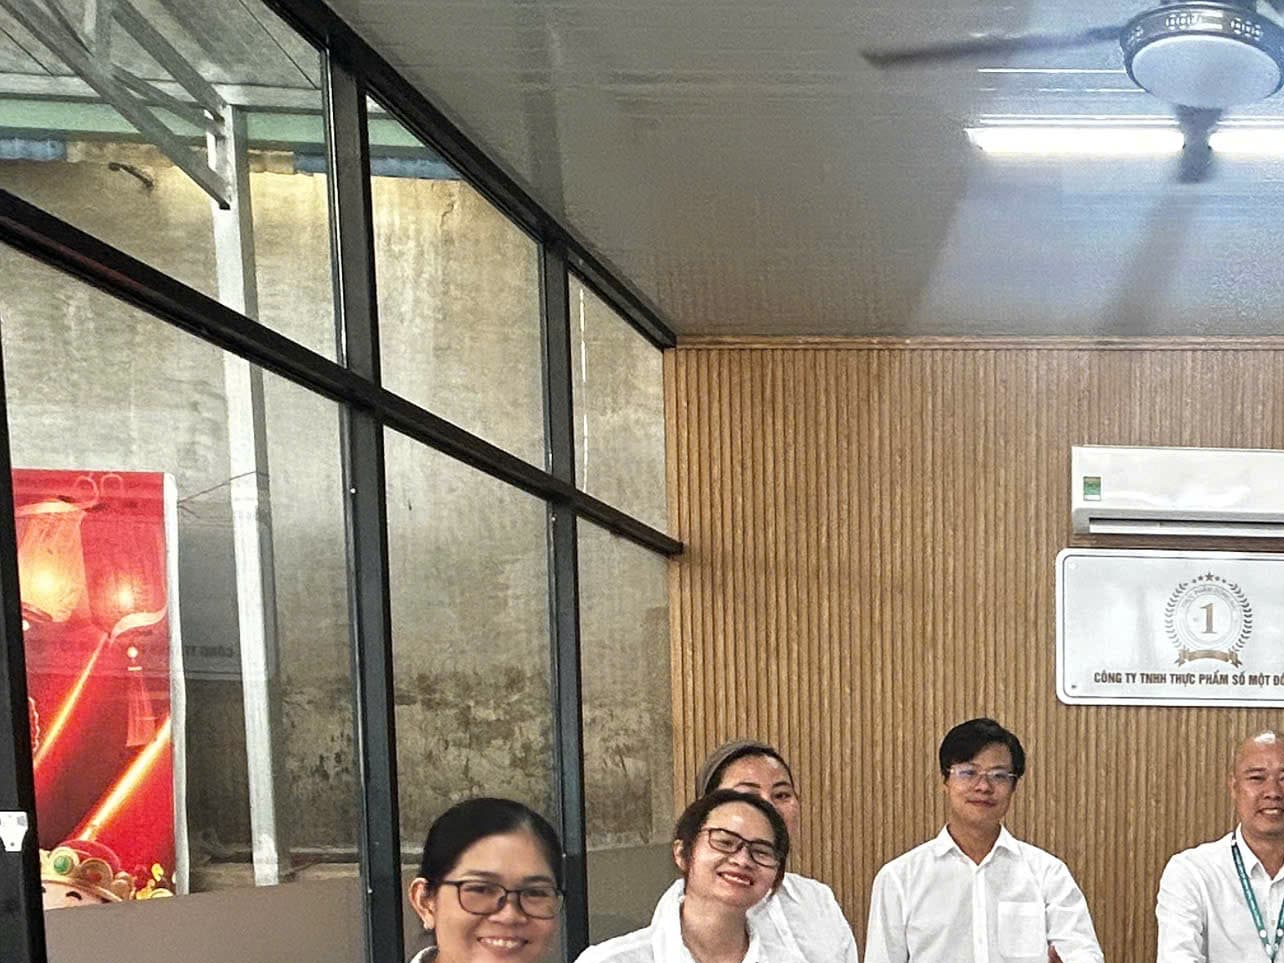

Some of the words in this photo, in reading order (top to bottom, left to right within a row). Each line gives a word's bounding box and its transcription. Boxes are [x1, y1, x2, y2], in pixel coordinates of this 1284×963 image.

[1199, 602, 1217, 634] 1
[1093, 669, 1122, 684] CÔNG
[1124, 672, 1137, 684] TY
[1140, 672, 1167, 684] TNHH
[1169, 672, 1196, 687] THỰC
[1199, 669, 1229, 685] PHẨM
[1232, 669, 1246, 686] SỐ
[1249, 671, 1271, 687] MỘT
